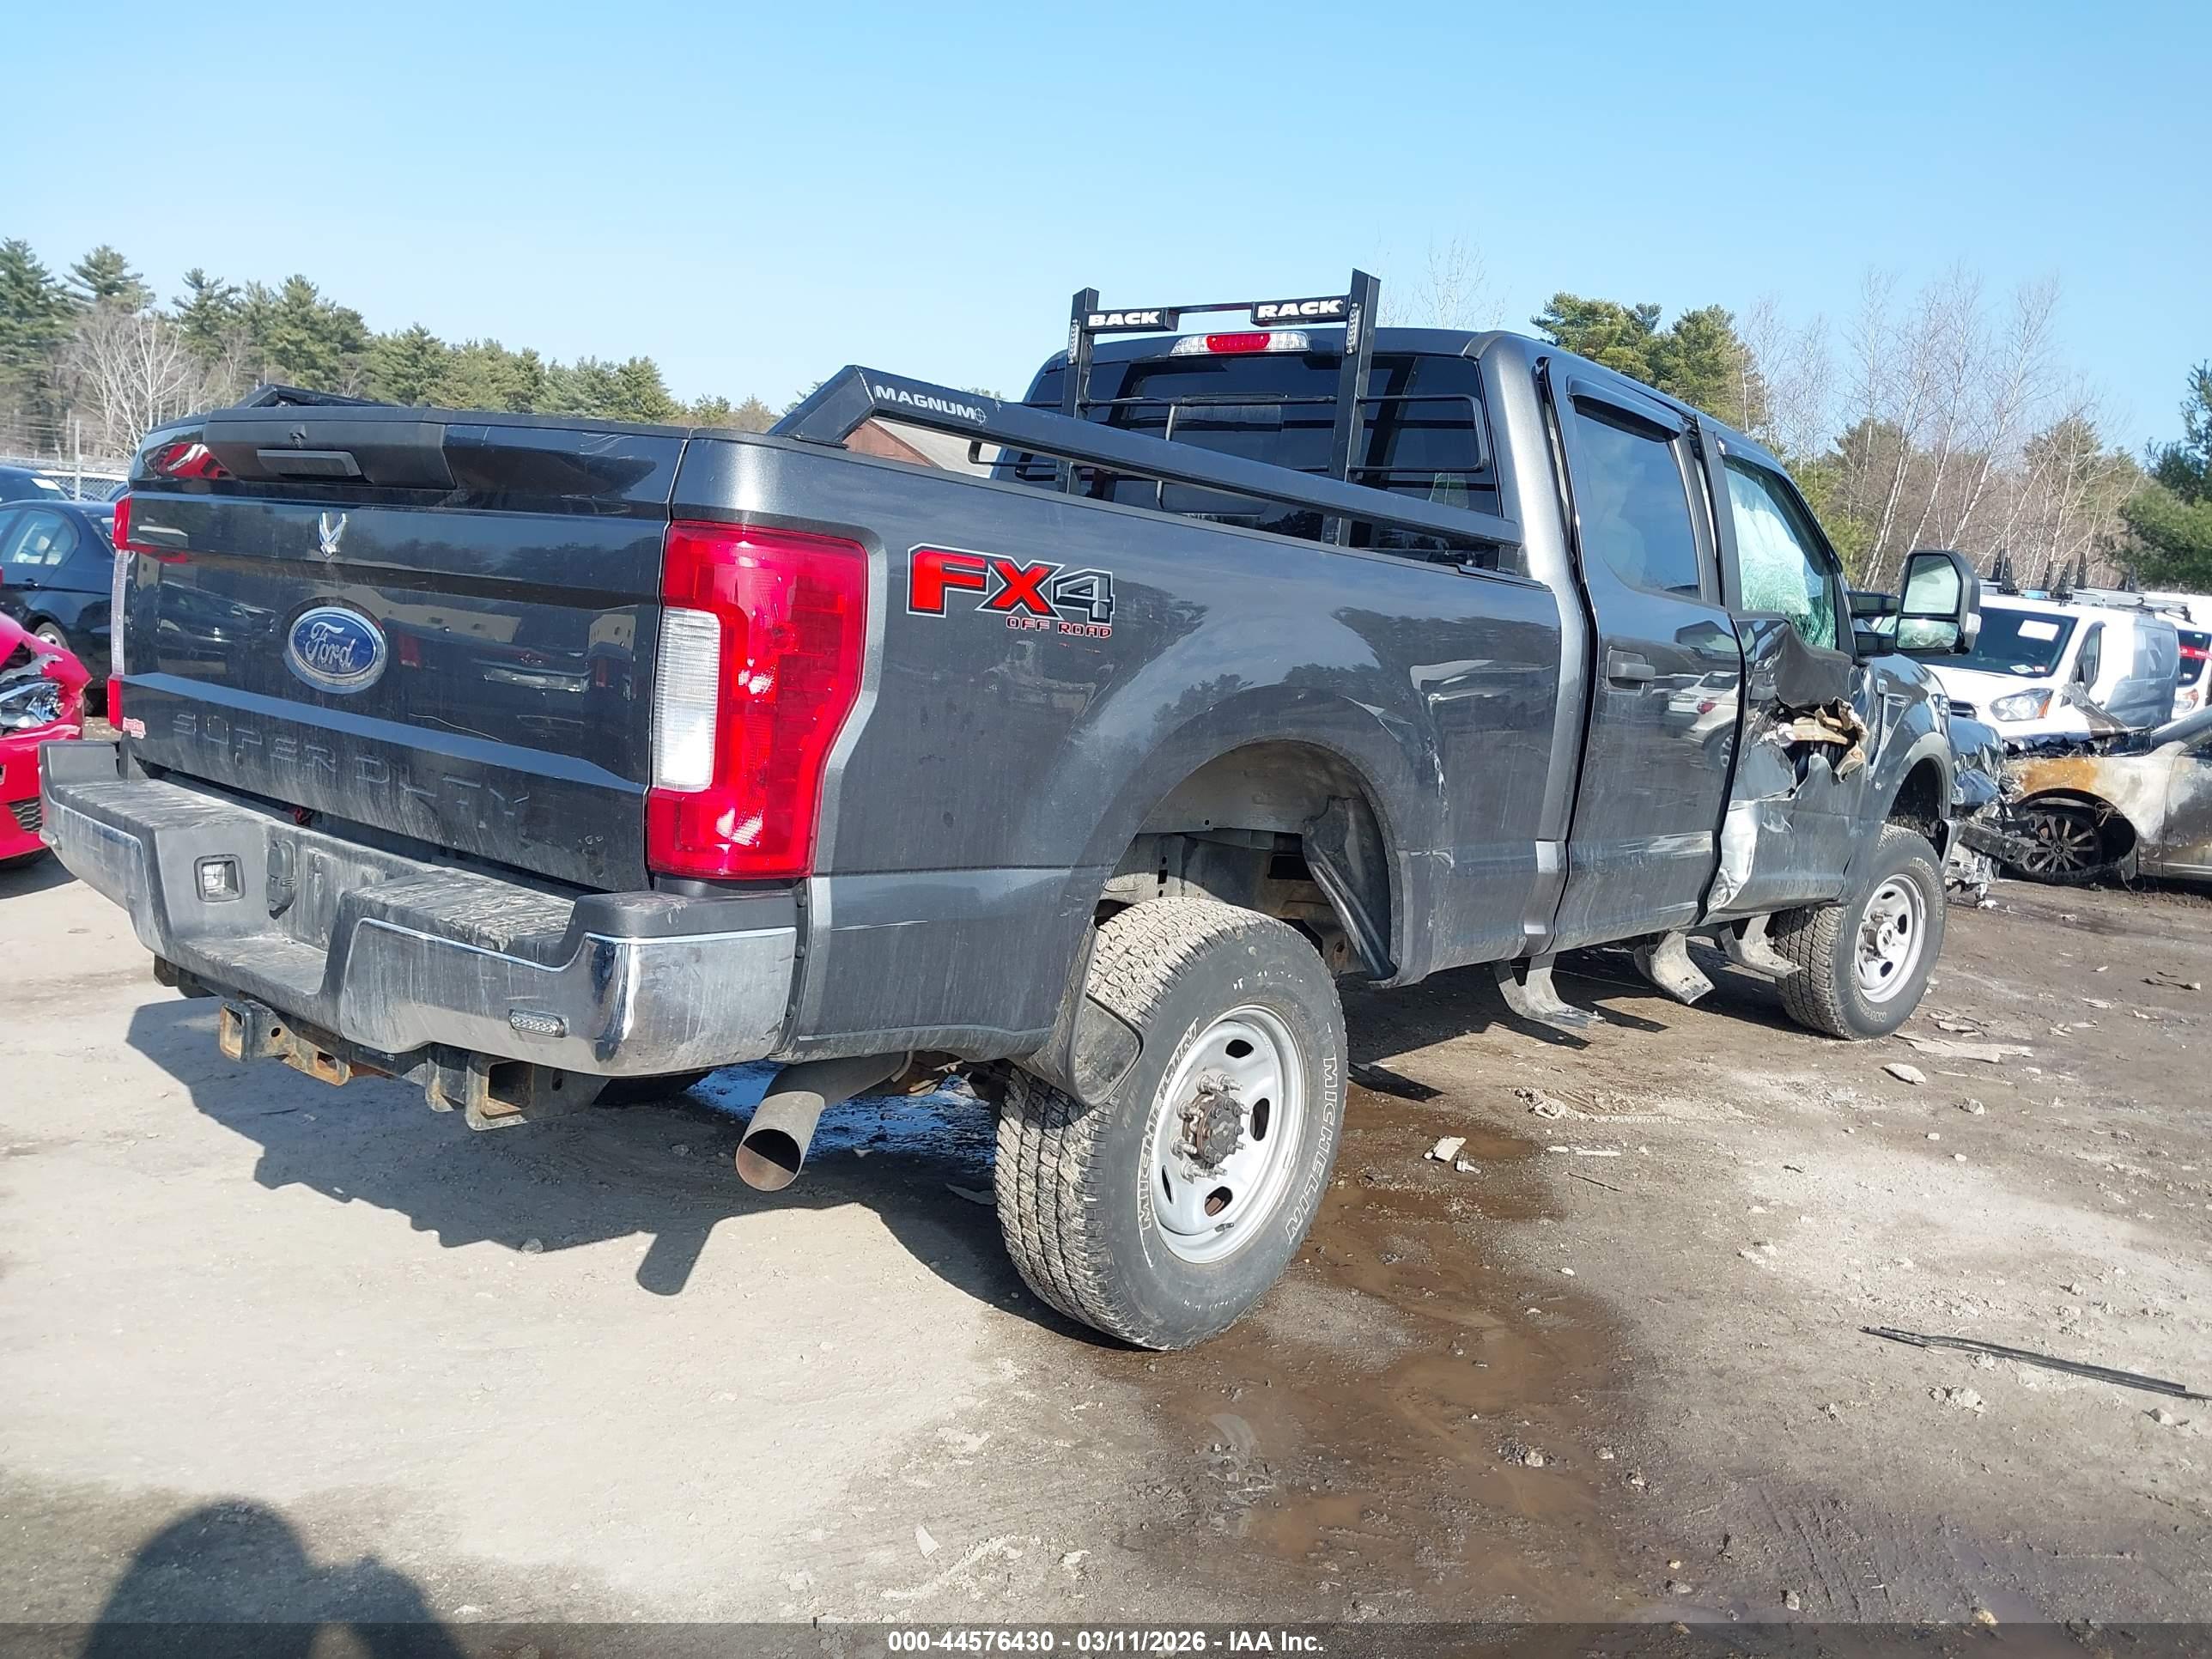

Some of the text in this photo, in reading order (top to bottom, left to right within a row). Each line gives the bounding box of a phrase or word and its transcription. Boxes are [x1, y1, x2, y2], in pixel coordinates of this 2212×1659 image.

[1087, 299, 1343, 327] BACK RACK
[873, 384, 976, 421] MAGNUM
[906, 543, 1115, 626] FX4
[305, 621, 357, 670] Ford
[1006, 616, 1113, 639] OFF ROAD
[172, 712, 337, 773] SUPER
[1285, 1056, 1338, 1243] MICHELIN
